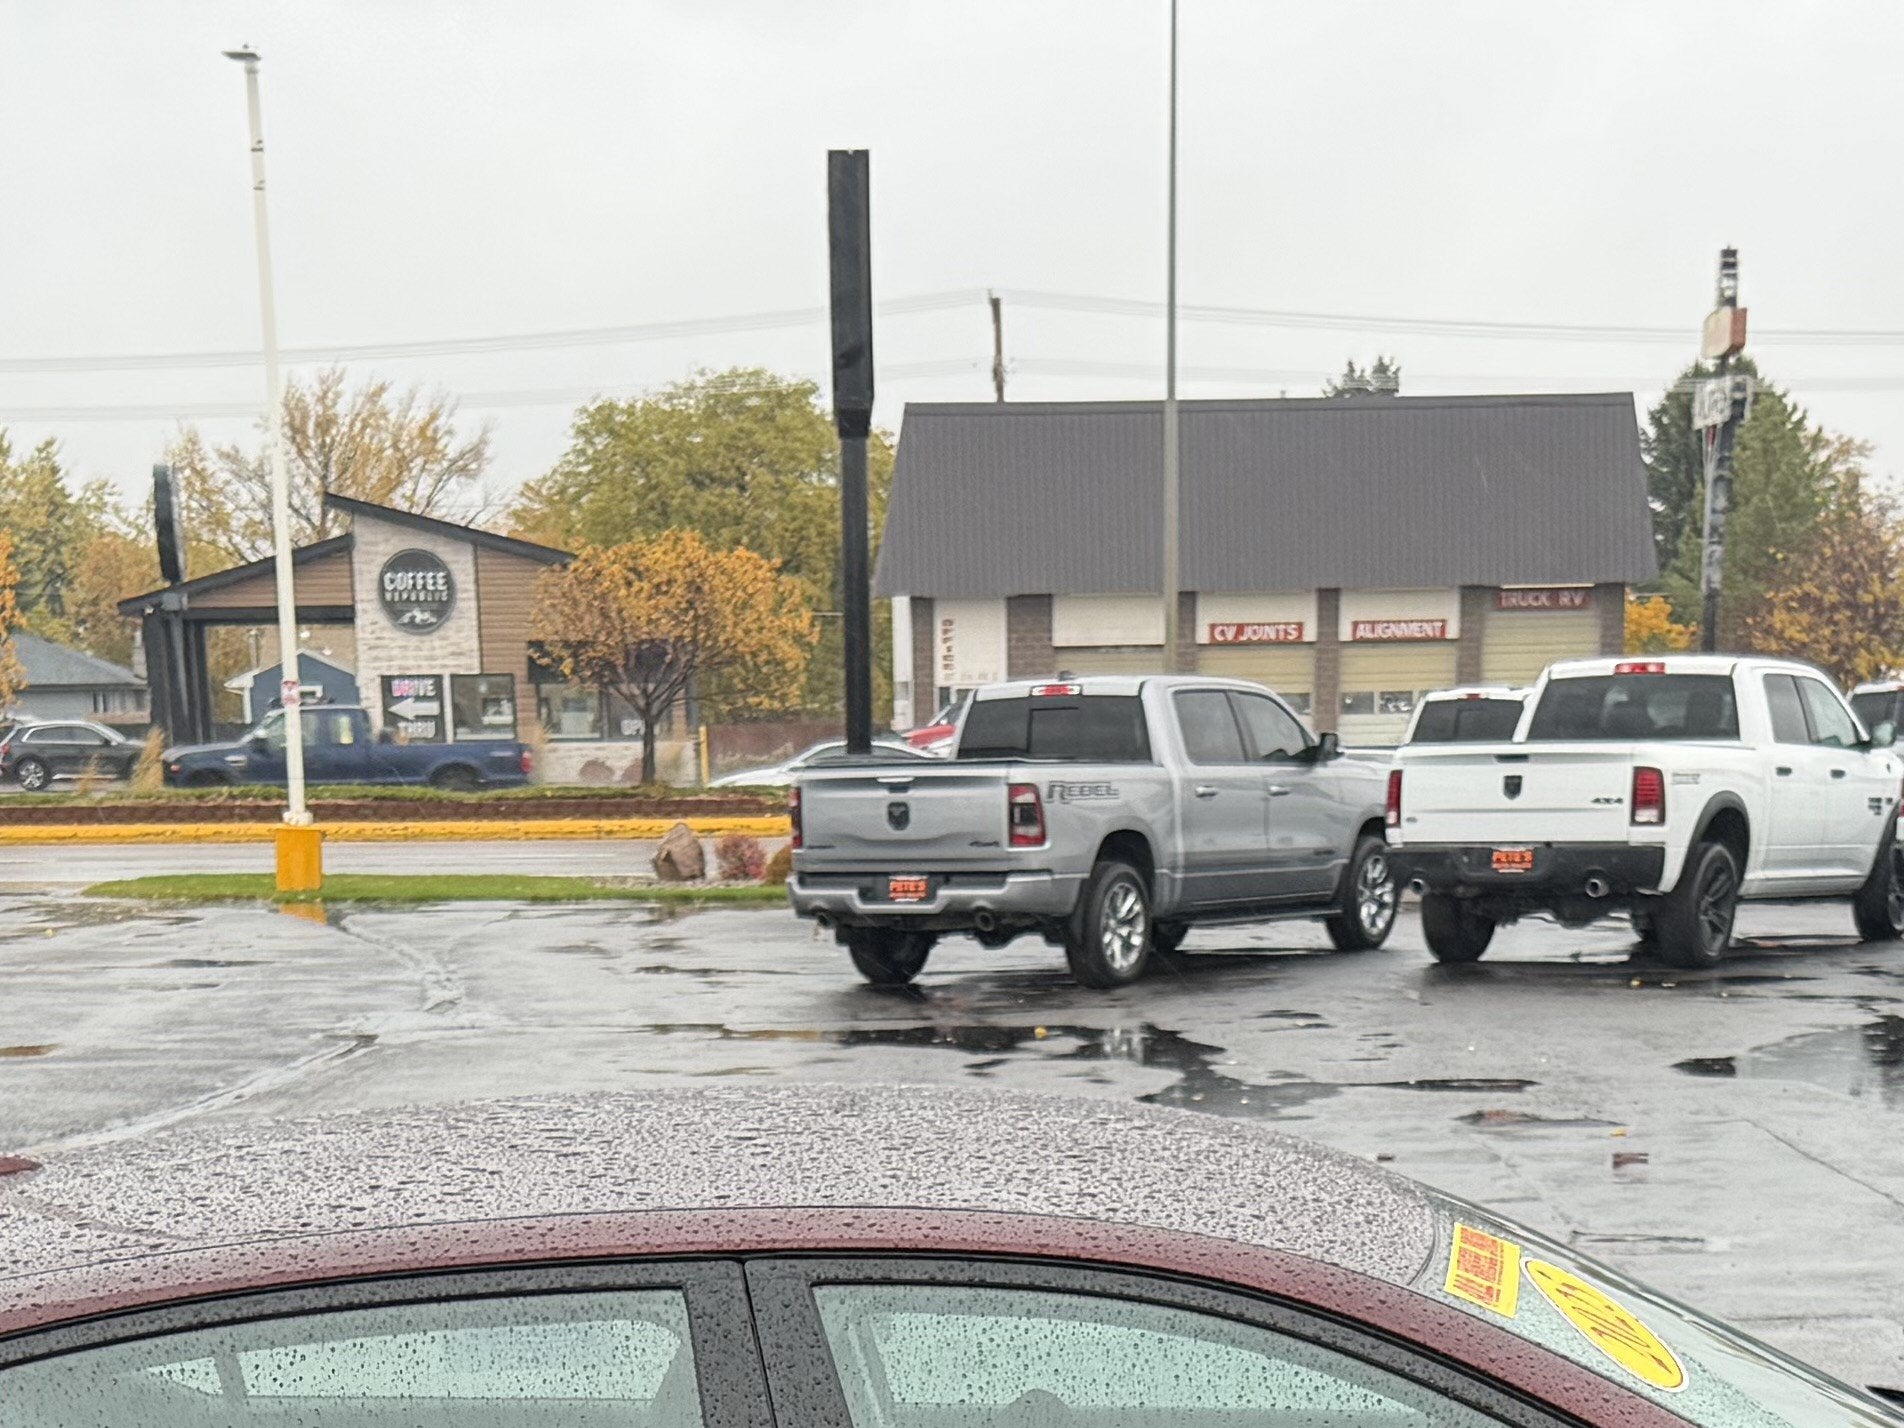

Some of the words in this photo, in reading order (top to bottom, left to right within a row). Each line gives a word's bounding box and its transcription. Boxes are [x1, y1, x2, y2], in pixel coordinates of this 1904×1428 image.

[383, 571, 448, 590] COFFEE
[1213, 624, 1237, 641] CV
[1239, 623, 1300, 641] JOINTS
[1356, 621, 1443, 640] ALIGNMENT
